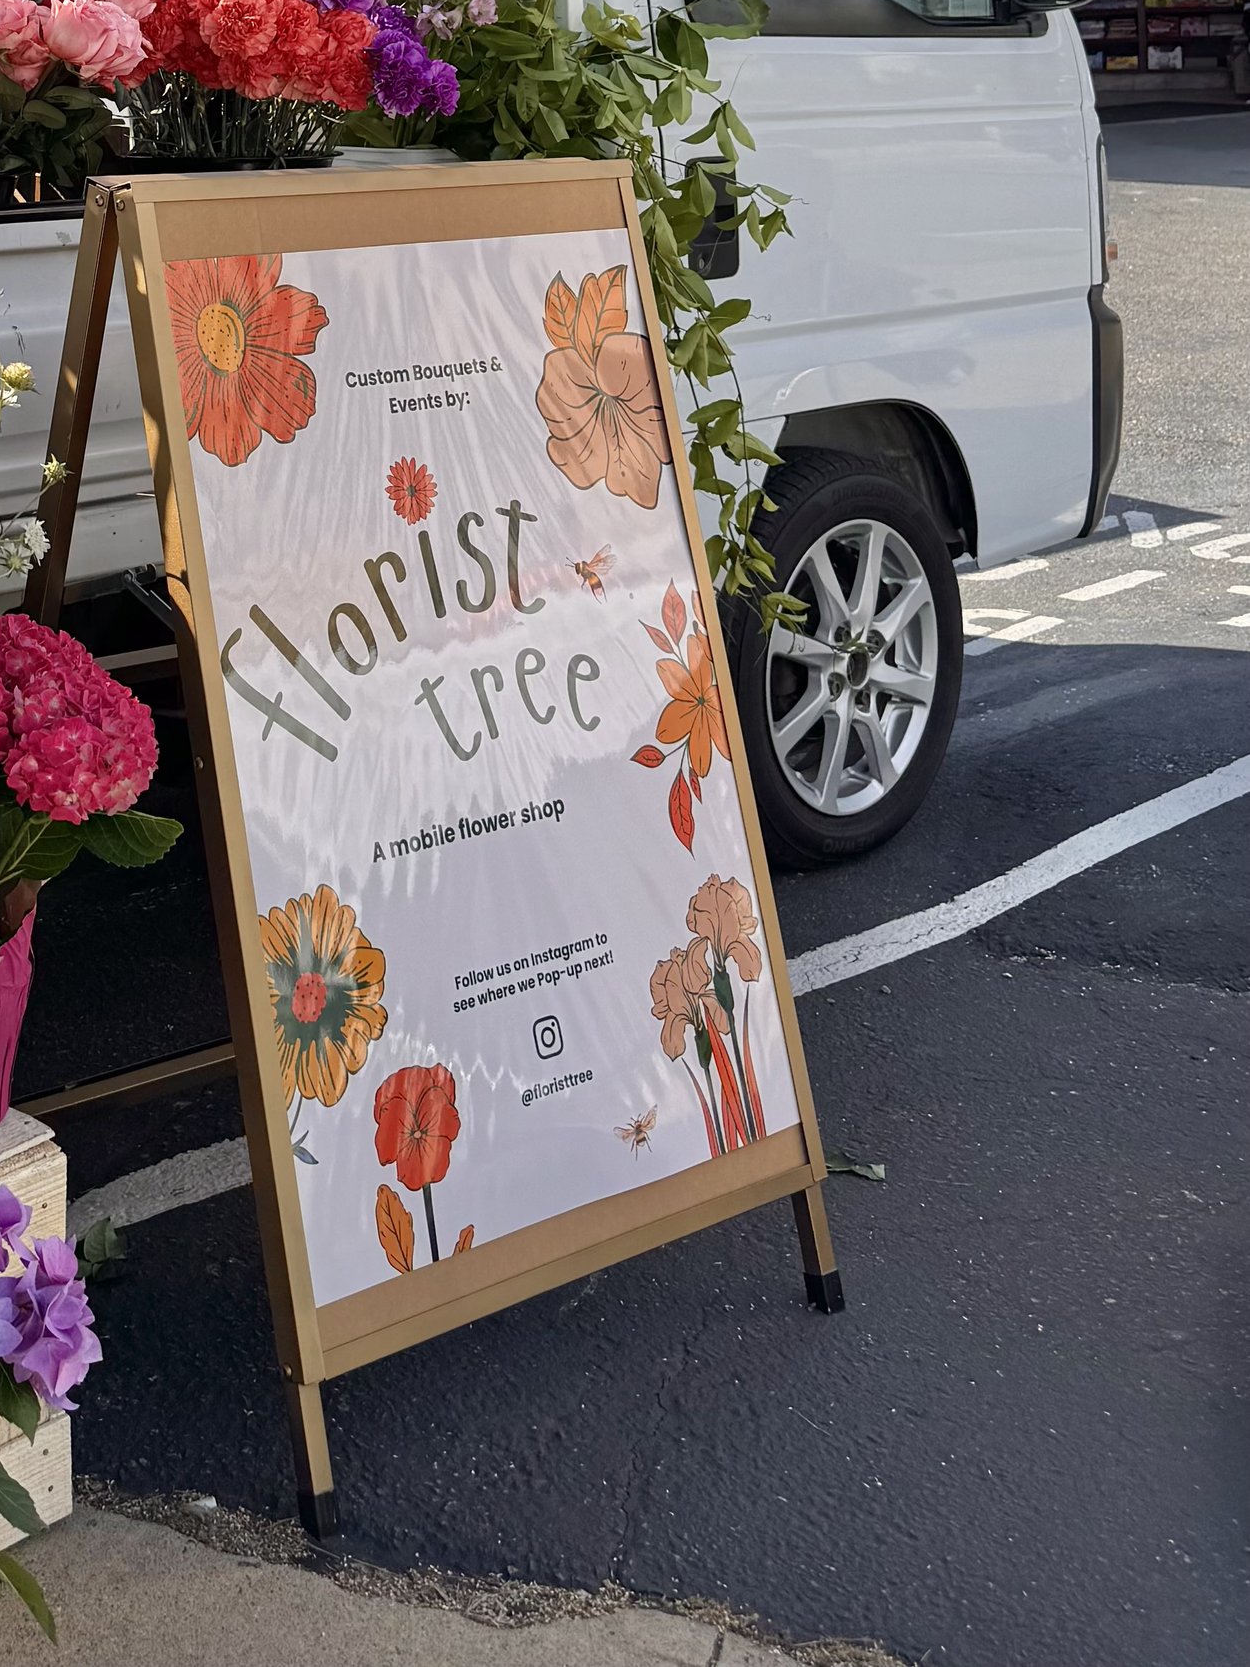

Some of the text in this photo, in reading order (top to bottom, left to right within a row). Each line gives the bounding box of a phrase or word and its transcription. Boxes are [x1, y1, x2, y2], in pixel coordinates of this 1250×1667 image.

[345, 356, 502, 388] Custom Bouquets &
[389, 390, 471, 414] Events by:
[220, 499, 545, 762] florist
[414, 647, 601, 761] tree
[372, 798, 565, 863] A mobile flower shop
[453, 950, 615, 1013] see where we Pop-up next!
[454, 933, 608, 990] Follow us on Instagram to
[521, 1069, 594, 1107] @floristtree
